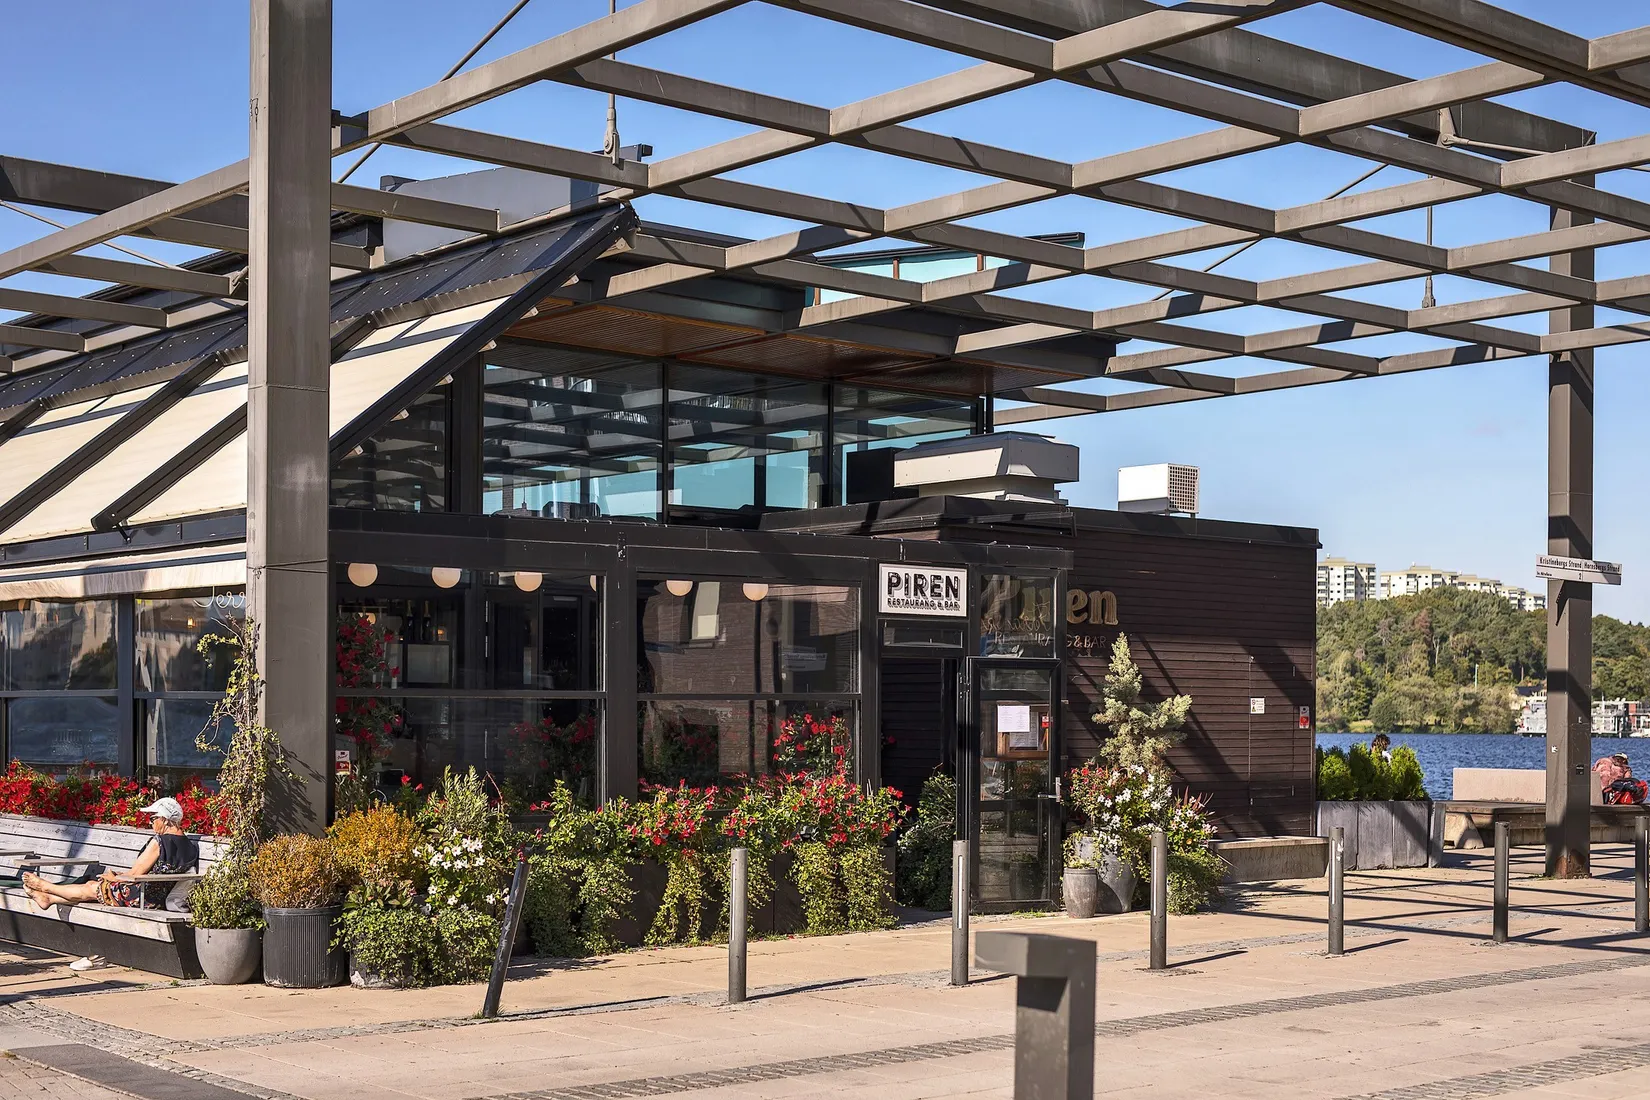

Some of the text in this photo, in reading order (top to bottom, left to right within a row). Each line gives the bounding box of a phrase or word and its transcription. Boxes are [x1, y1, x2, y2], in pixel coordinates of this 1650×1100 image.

[1540, 557, 1582, 569] Kristinebergs Strand
[1584, 562, 1620, 573] Hornsbergs Strand
[888, 572, 961, 601] PIREN
[887, 598, 961, 612] RESTAURANG & BAR
